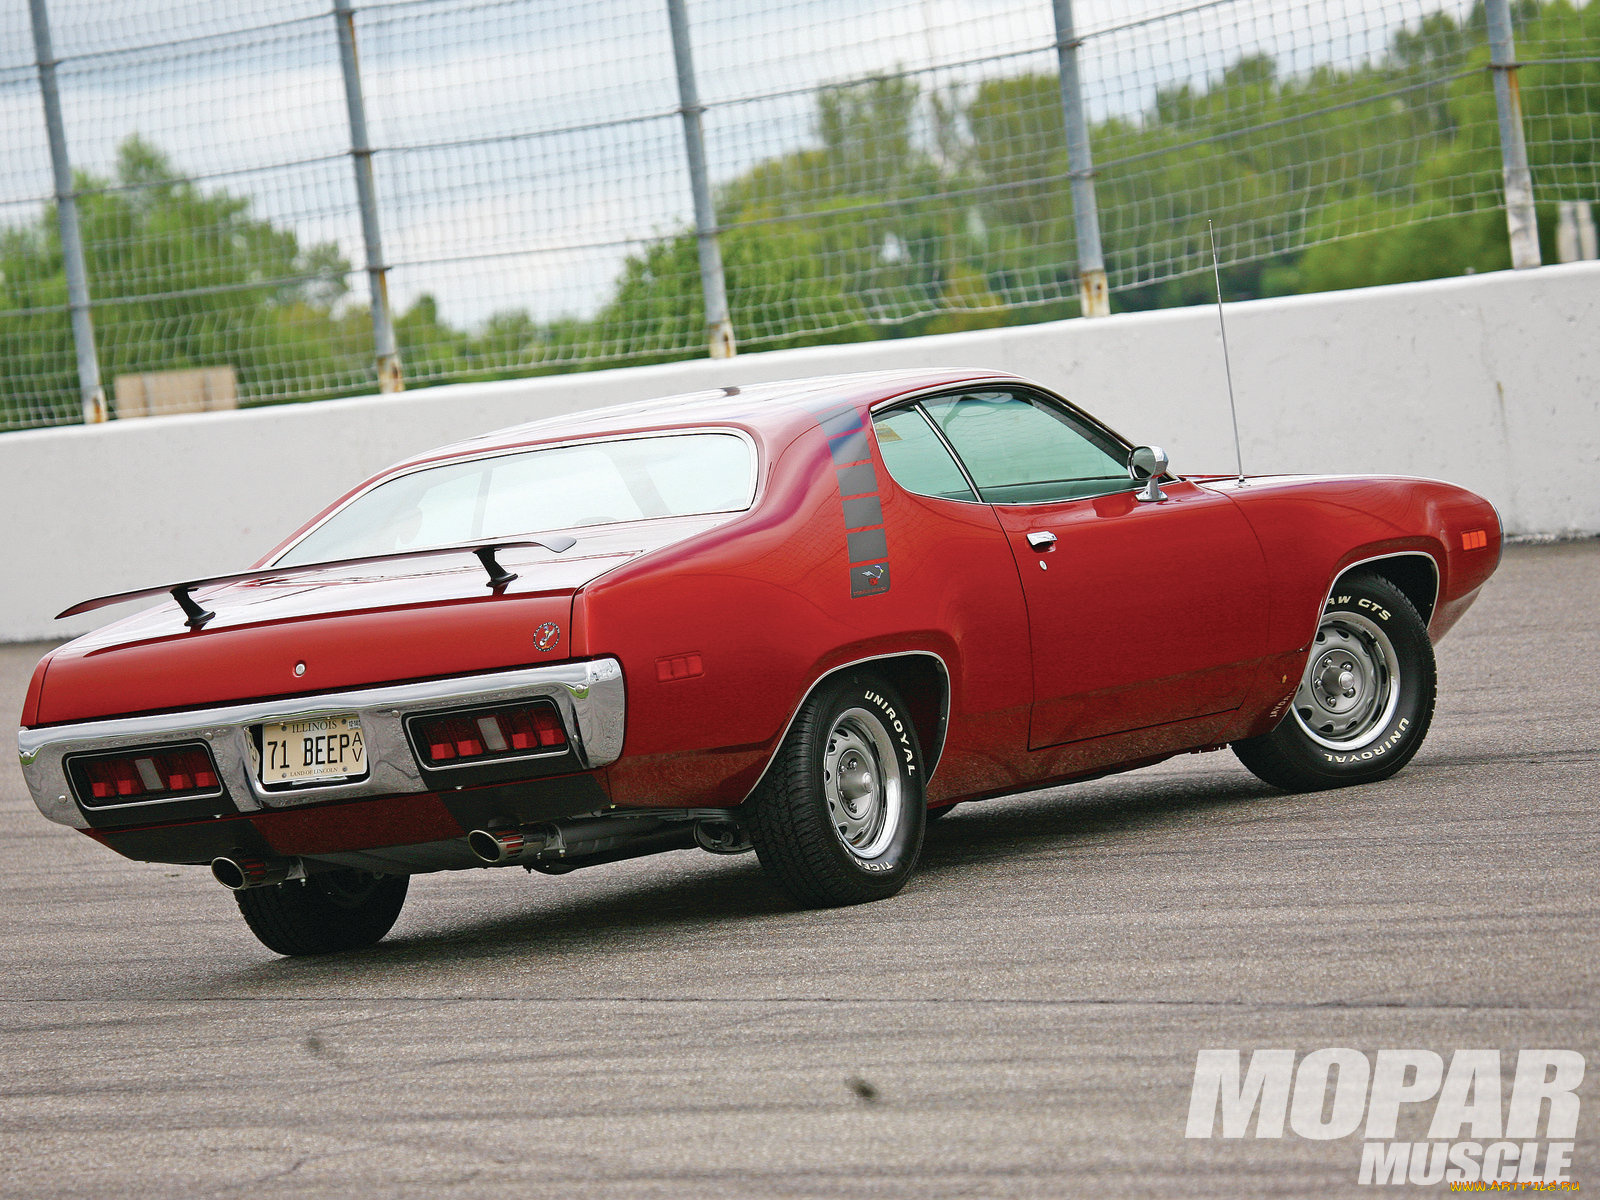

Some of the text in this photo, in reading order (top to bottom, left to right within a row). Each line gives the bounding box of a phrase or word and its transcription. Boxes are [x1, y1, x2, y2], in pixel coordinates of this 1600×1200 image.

[1328, 595, 1392, 621] AW GTS
[292, 720, 338, 733] ILLINOIS
[864, 690, 917, 776] UNIROYAL
[352, 731, 363, 746] A
[1324, 717, 1410, 763] UNIROYAL
[267, 734, 350, 770] 71 BEEP
[352, 747, 363, 762] V
[313, 767, 338, 775] LINCOLN
